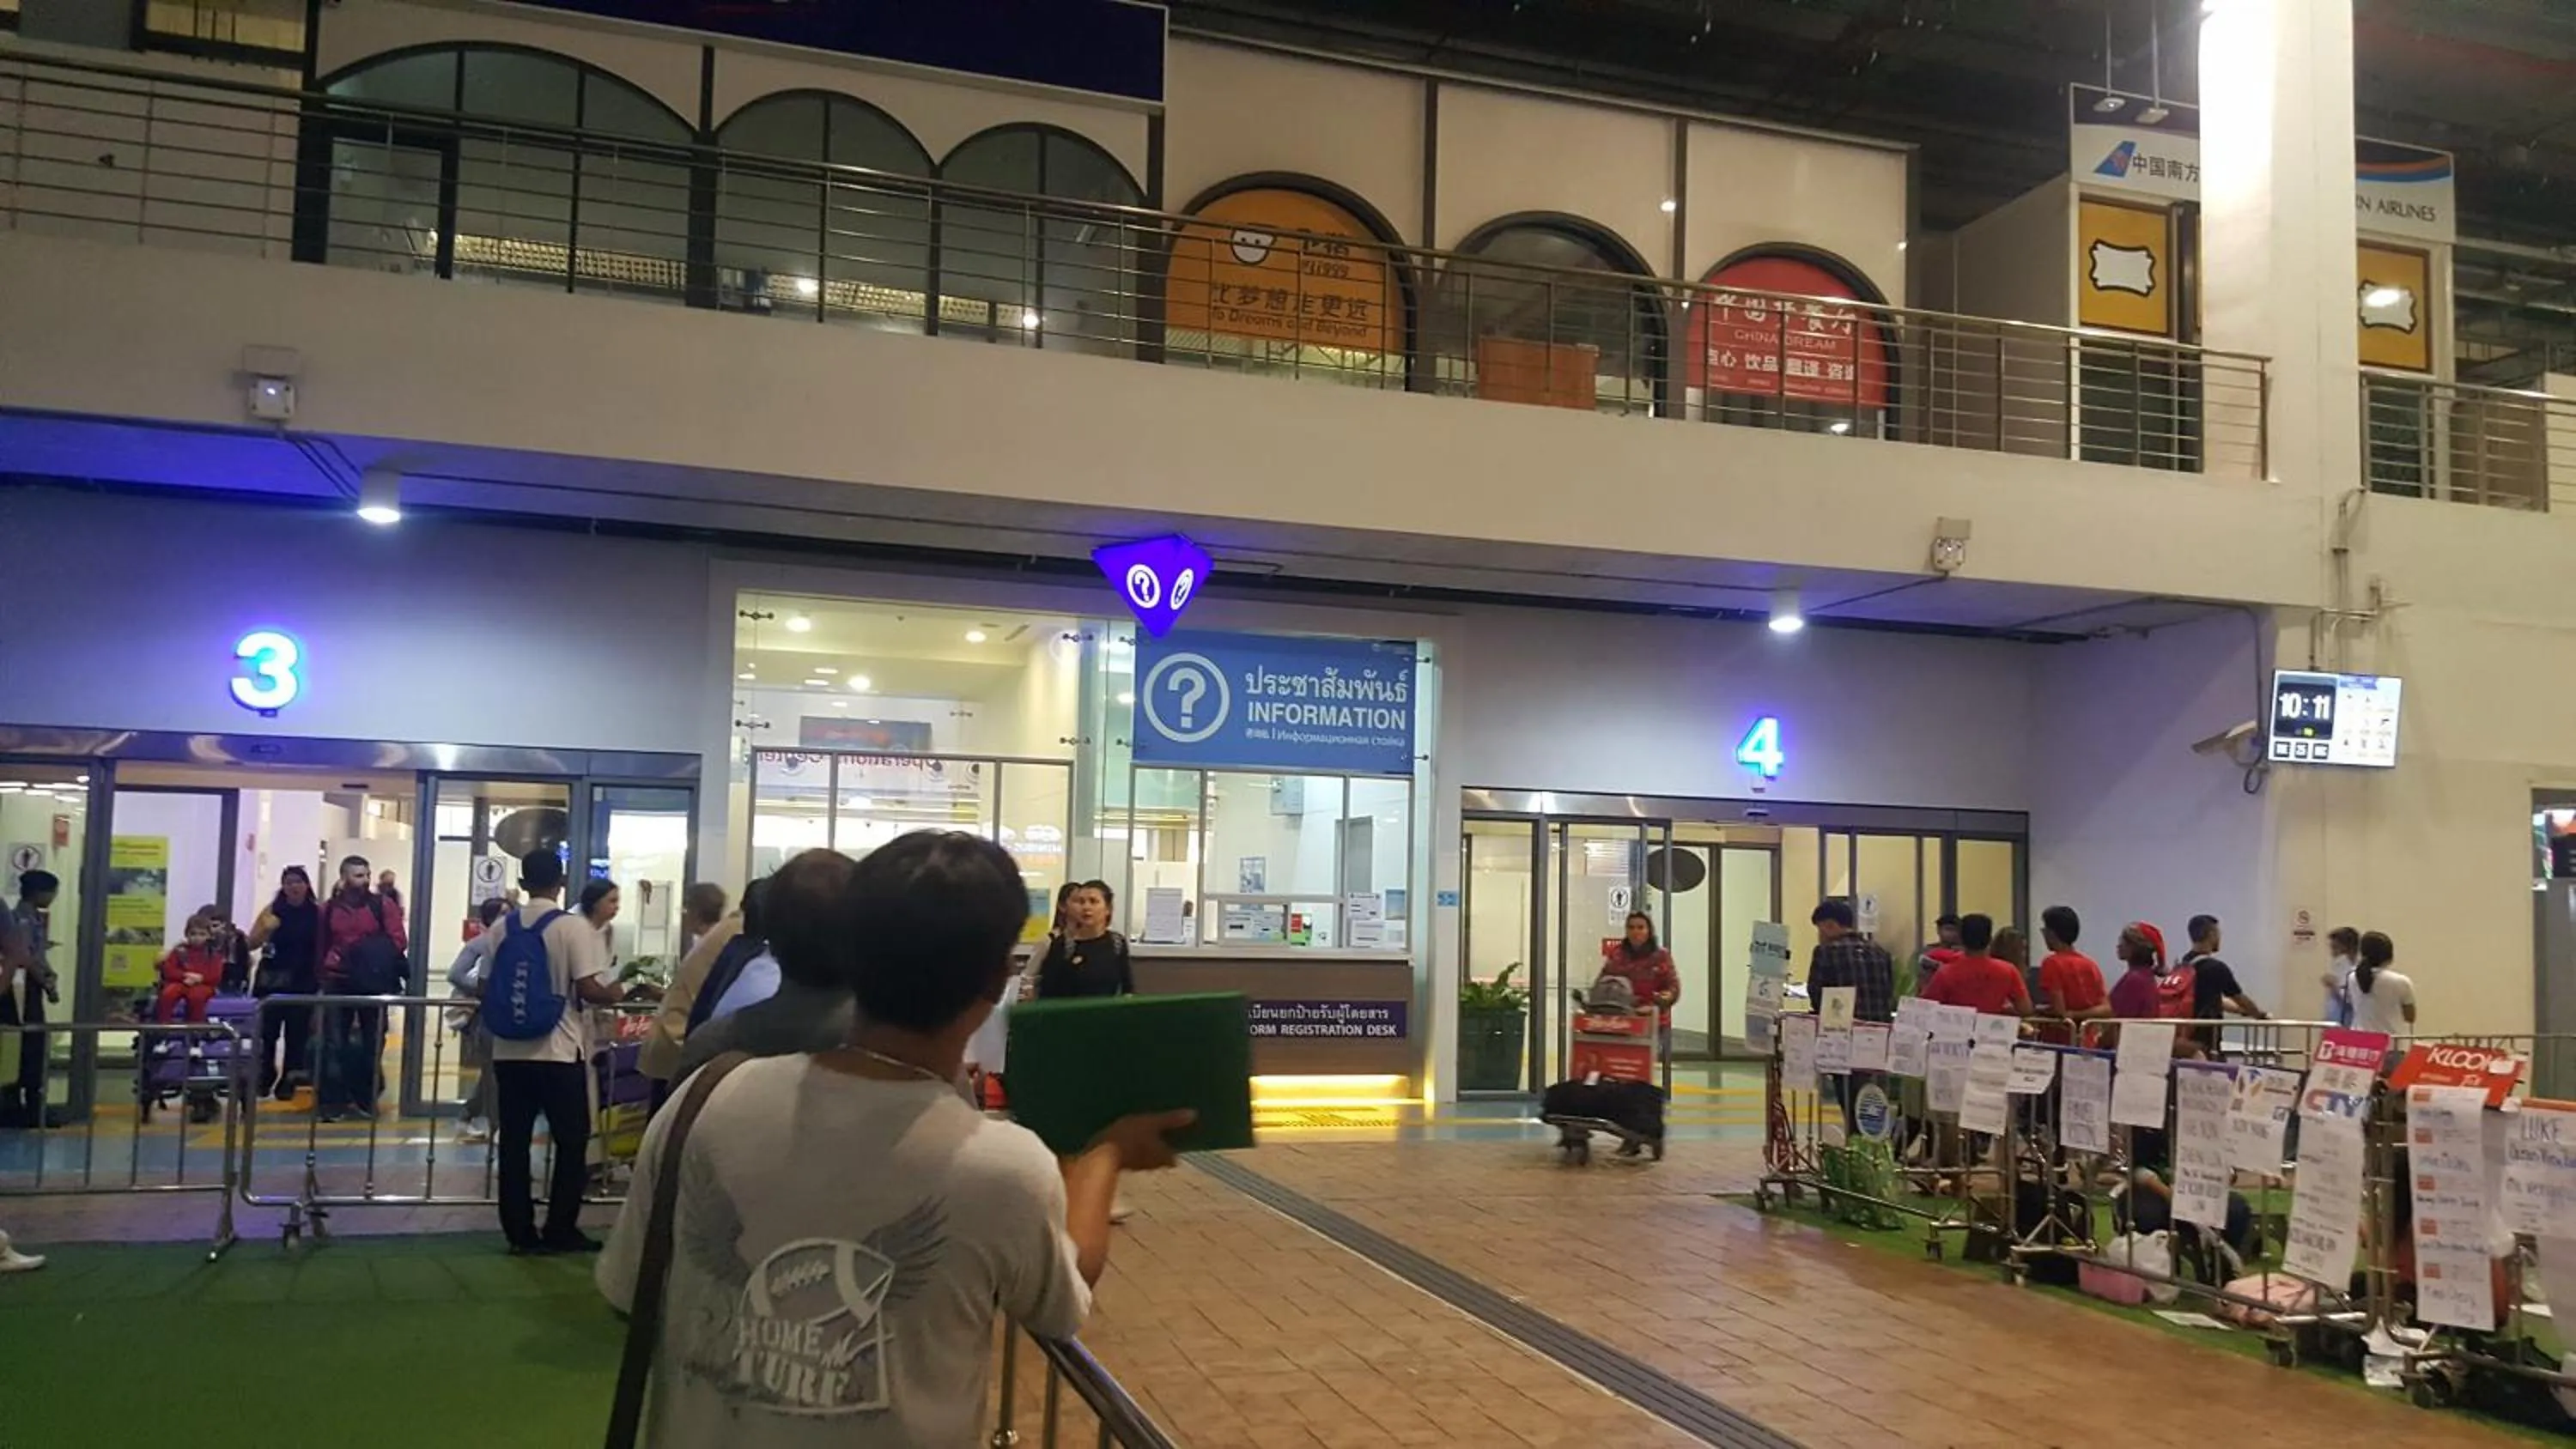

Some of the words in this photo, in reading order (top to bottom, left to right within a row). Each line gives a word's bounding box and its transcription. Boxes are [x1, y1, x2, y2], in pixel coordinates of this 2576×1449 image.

[2376, 197, 2437, 222] AIRLINES
[1735, 328, 1778, 345] CHINA
[230, 632, 299, 711] 3
[1244, 665, 1410, 703] ประชาสัมพันธ์
[1248, 700, 1407, 731] INFORMATION
[1735, 716, 1783, 779] 4
[1280, 1024, 1364, 1036] REGISTRATION
[1366, 1025, 1397, 1036] DESK
[736, 1316, 824, 1359] HOME
